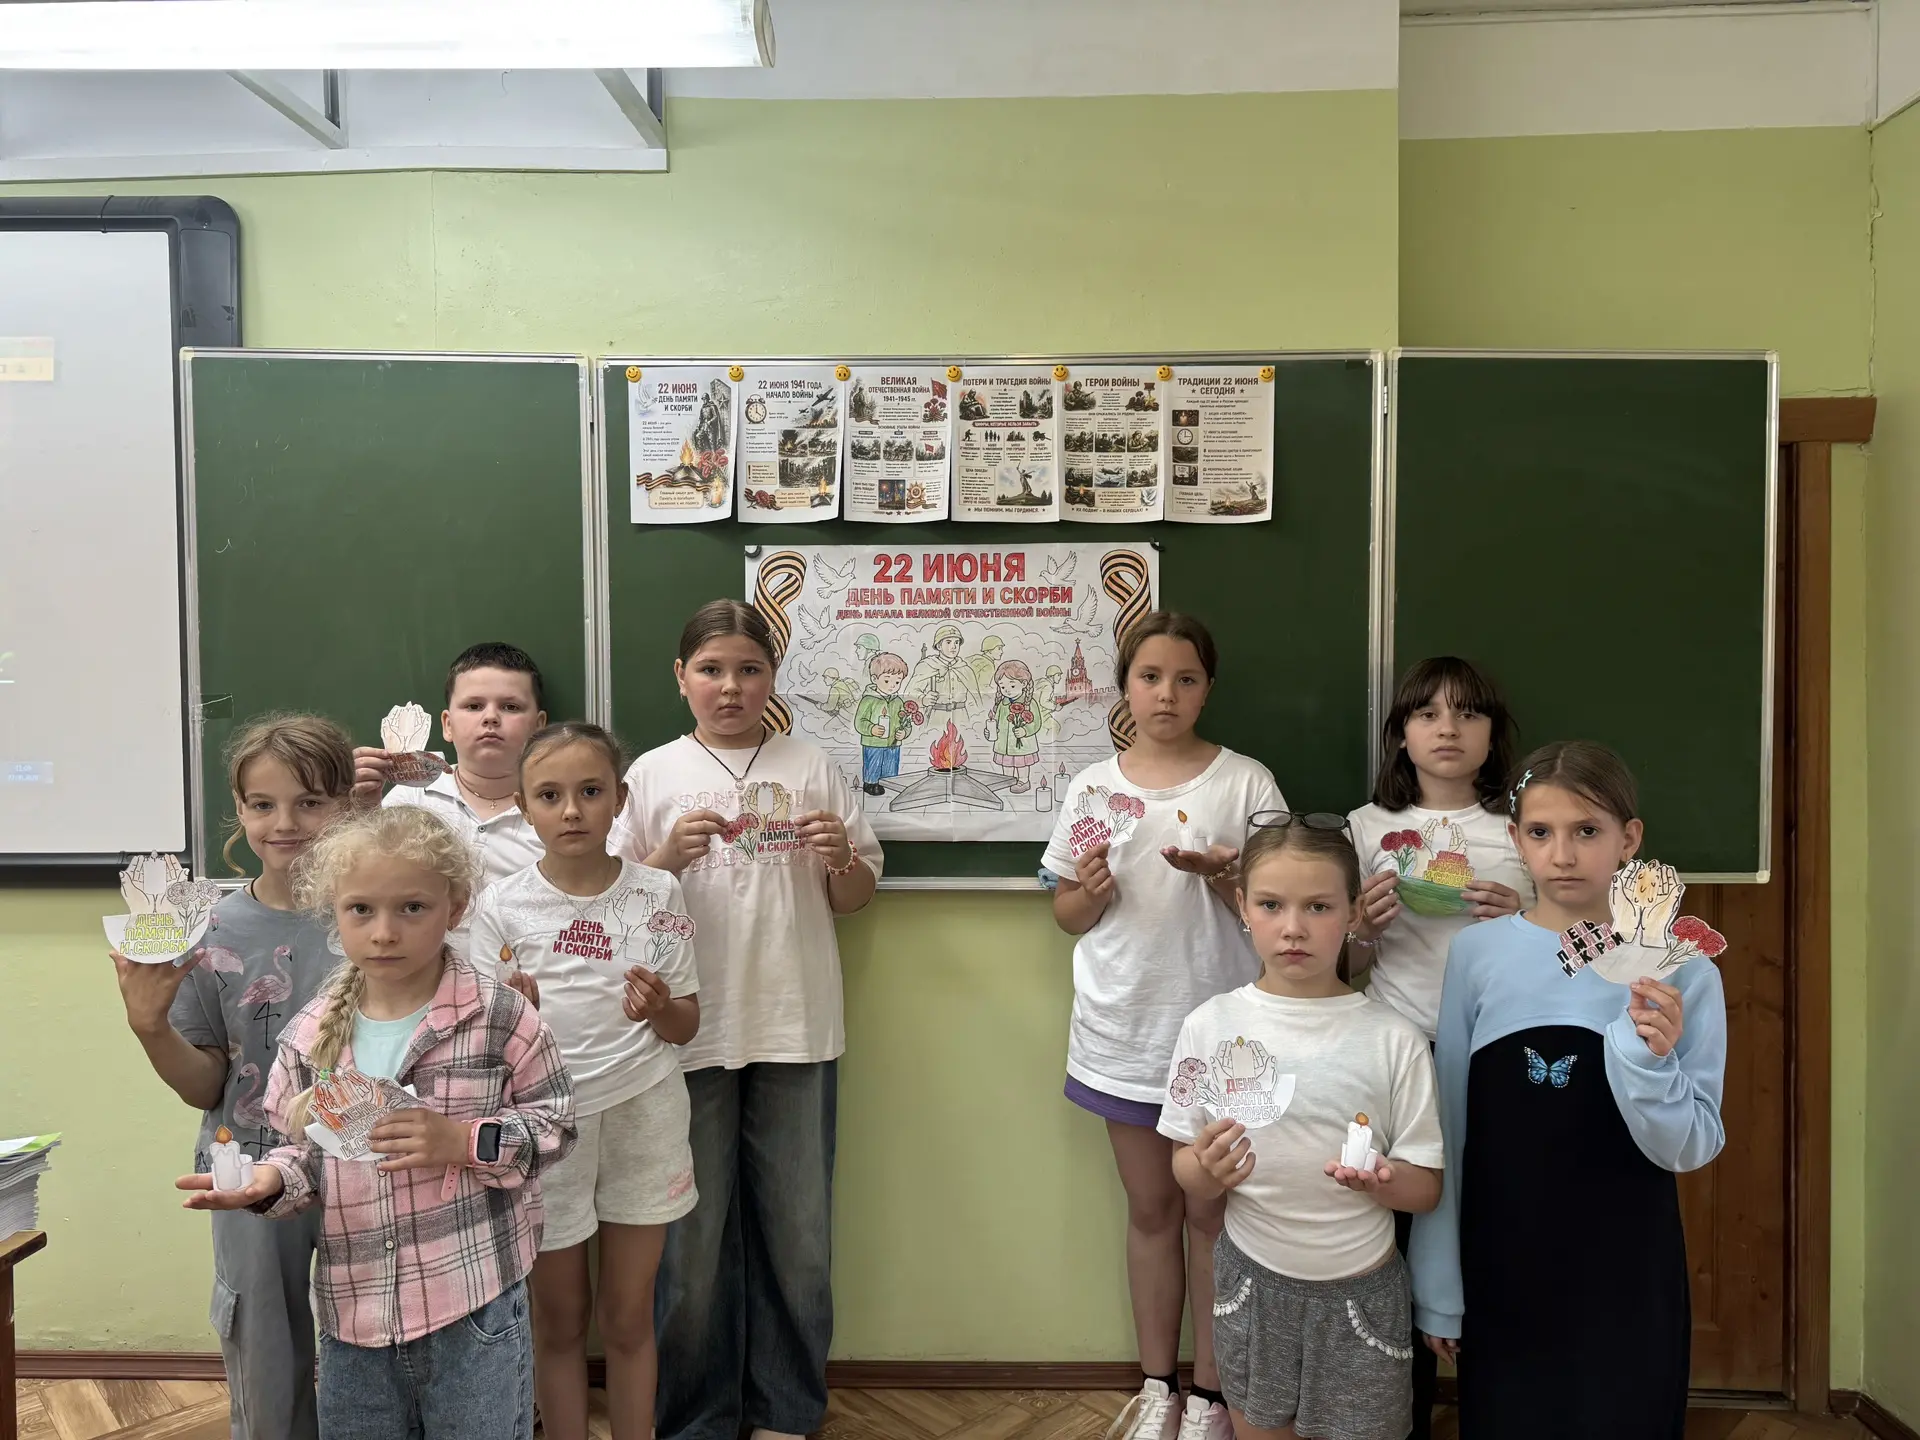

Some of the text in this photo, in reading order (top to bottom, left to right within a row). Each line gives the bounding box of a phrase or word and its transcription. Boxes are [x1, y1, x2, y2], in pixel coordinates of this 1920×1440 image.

[758, 380, 822, 390] 22 ИЮНЯ 1941 ГОДА
[881, 377, 917, 385] ВЕЛИКАЯ
[995, 378, 1027, 386] ТРАГЕДИЯ
[1029, 377, 1051, 386] ВОЙНЫ
[1085, 377, 1140, 387] ГЕРОИ ВОЙНЫ
[1178, 378, 1220, 386] ТРАДИЦИИ
[1235, 377, 1258, 385] ИЮНЯ
[658, 383, 697, 394] 22 ИЮНЯ
[766, 390, 814, 399] НАЧАЛО ВОЙНЫ
[869, 385, 930, 394] ОТЕЧЕСТВЕННАЯ ВОЙНА
[1200, 387, 1235, 396] СЕГОДНЯ
[658, 396, 674, 404] ДЕНЬ
[873, 552, 1026, 583] 22 ИЮНЯ
[845, 586, 1073, 607] ДЕНЬ ПАМЯТИ И СКОРБИ
[836, 605, 1072, 620] ДЕНЬ НАЧАЛА ВЕЛИКОЙ ОТЕЧЕСТВЕННОЙ ВОЙНЫ
[767, 820, 795, 832] ДЕНЬ
[1071, 816, 1095, 835] ДЕНЬ
[1069, 820, 1106, 847] ПАМЯТИ
[757, 839, 806, 852] И СКОРБИ
[1071, 827, 1112, 858] И СКОРБИ
[136, 914, 174, 927] ДЕНЬ
[570, 920, 604, 934] ДЕНЬ
[126, 926, 184, 940] ПАМЯТИ
[559, 930, 612, 948] ПАМЯТИ
[1560, 920, 1596, 947] ДЕНЬ
[120, 940, 189, 954] И СКОРБИ
[1556, 922, 1613, 964] ПАМЯТИ
[553, 941, 613, 961] И СКОРБИ
[1562, 932, 1625, 978] И СКОРБИ
[1226, 1077, 1262, 1094] ДЕНЬ
[1218, 1091, 1274, 1107] ПАМЯТИ
[1216, 1105, 1280, 1121] И СКОРБИ
[340, 1142, 354, 1160] И
